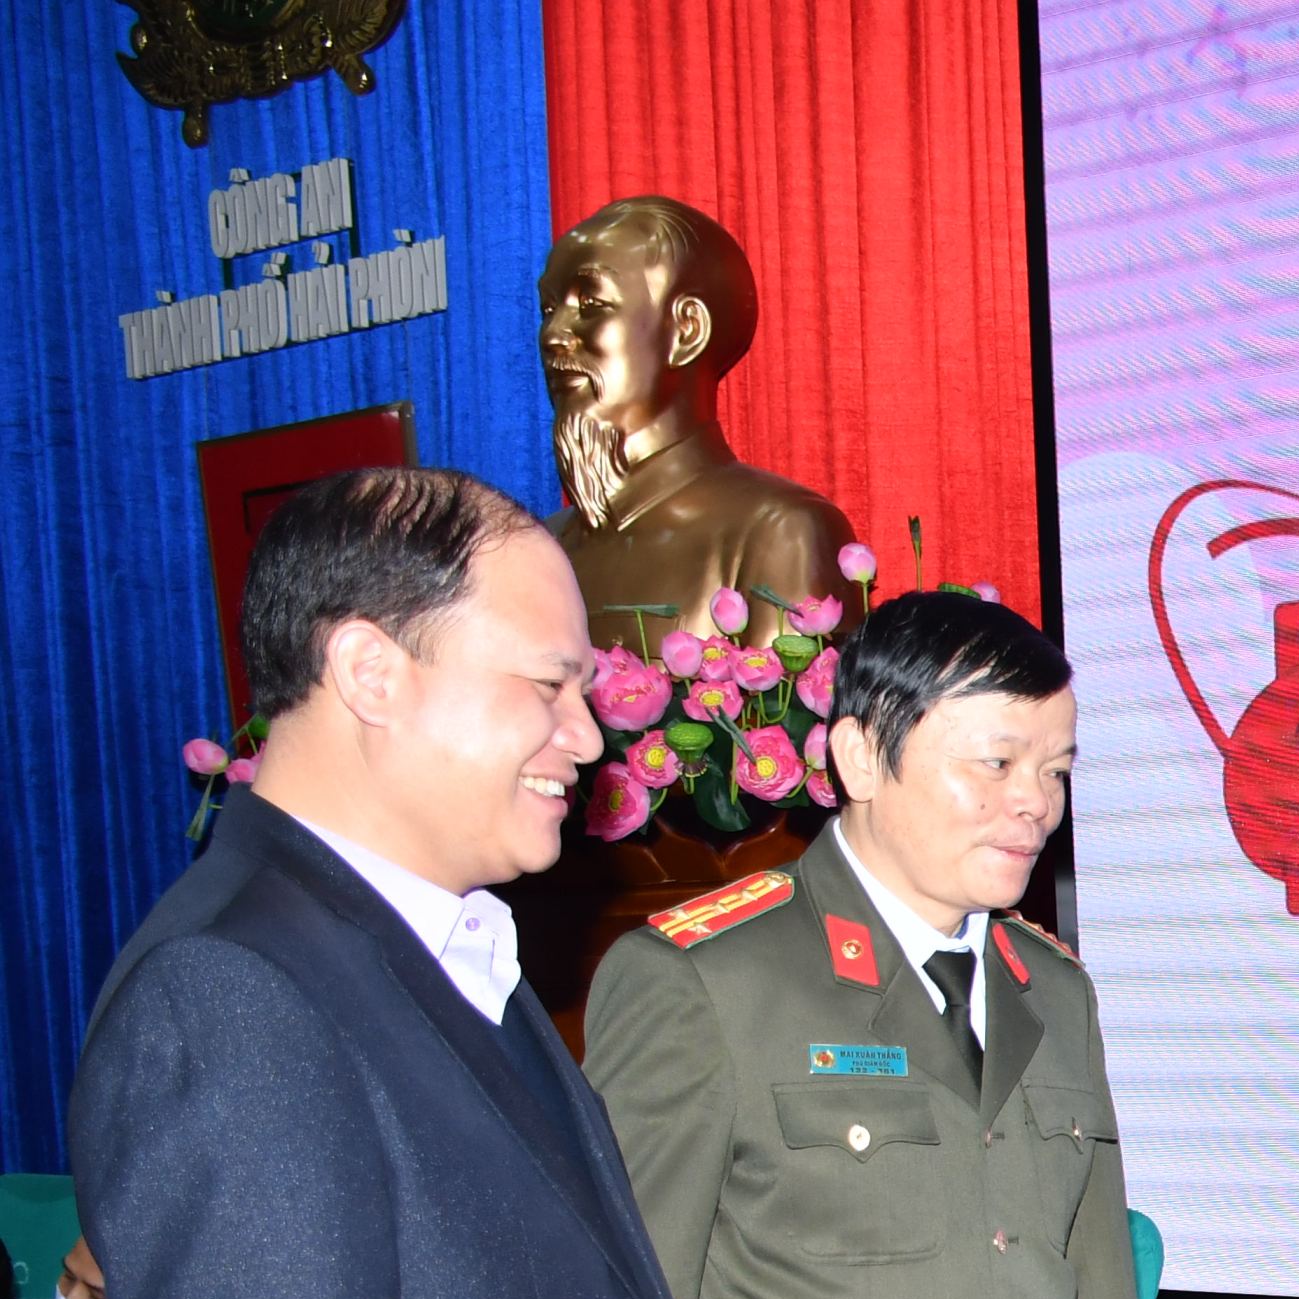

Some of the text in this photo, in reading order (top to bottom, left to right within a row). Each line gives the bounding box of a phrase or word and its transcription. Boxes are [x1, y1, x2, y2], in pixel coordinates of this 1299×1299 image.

[208, 158, 353, 259] CÔNG AN
[119, 290, 222, 379] THÀNH
[220, 252, 289, 358] PHỐ
[287, 241, 349, 342] HẢI
